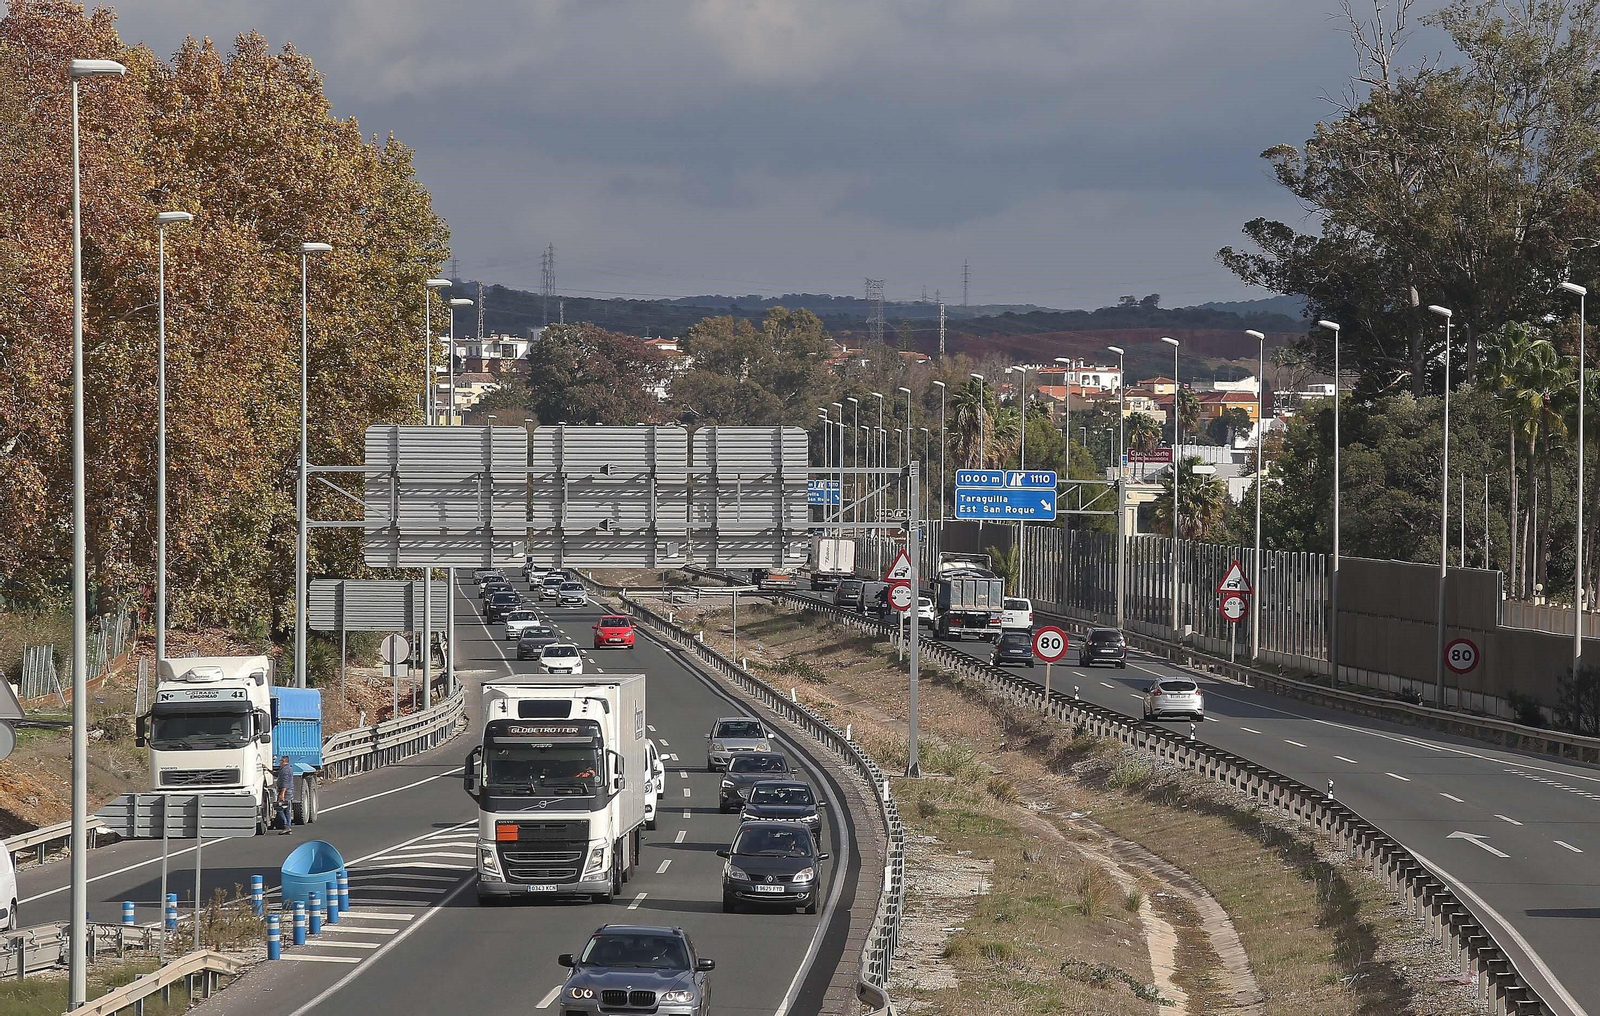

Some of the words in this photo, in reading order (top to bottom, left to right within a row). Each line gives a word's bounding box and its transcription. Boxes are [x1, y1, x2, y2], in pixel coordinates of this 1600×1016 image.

[960, 474, 988, 483] 1000
[1030, 474, 1050, 483] 1110
[1005, 506, 1035, 515] Roque
[1040, 636, 1061, 650] 80
[1451, 649, 1472, 662] 80
[509, 726, 578, 734] GLOBETROTTER
